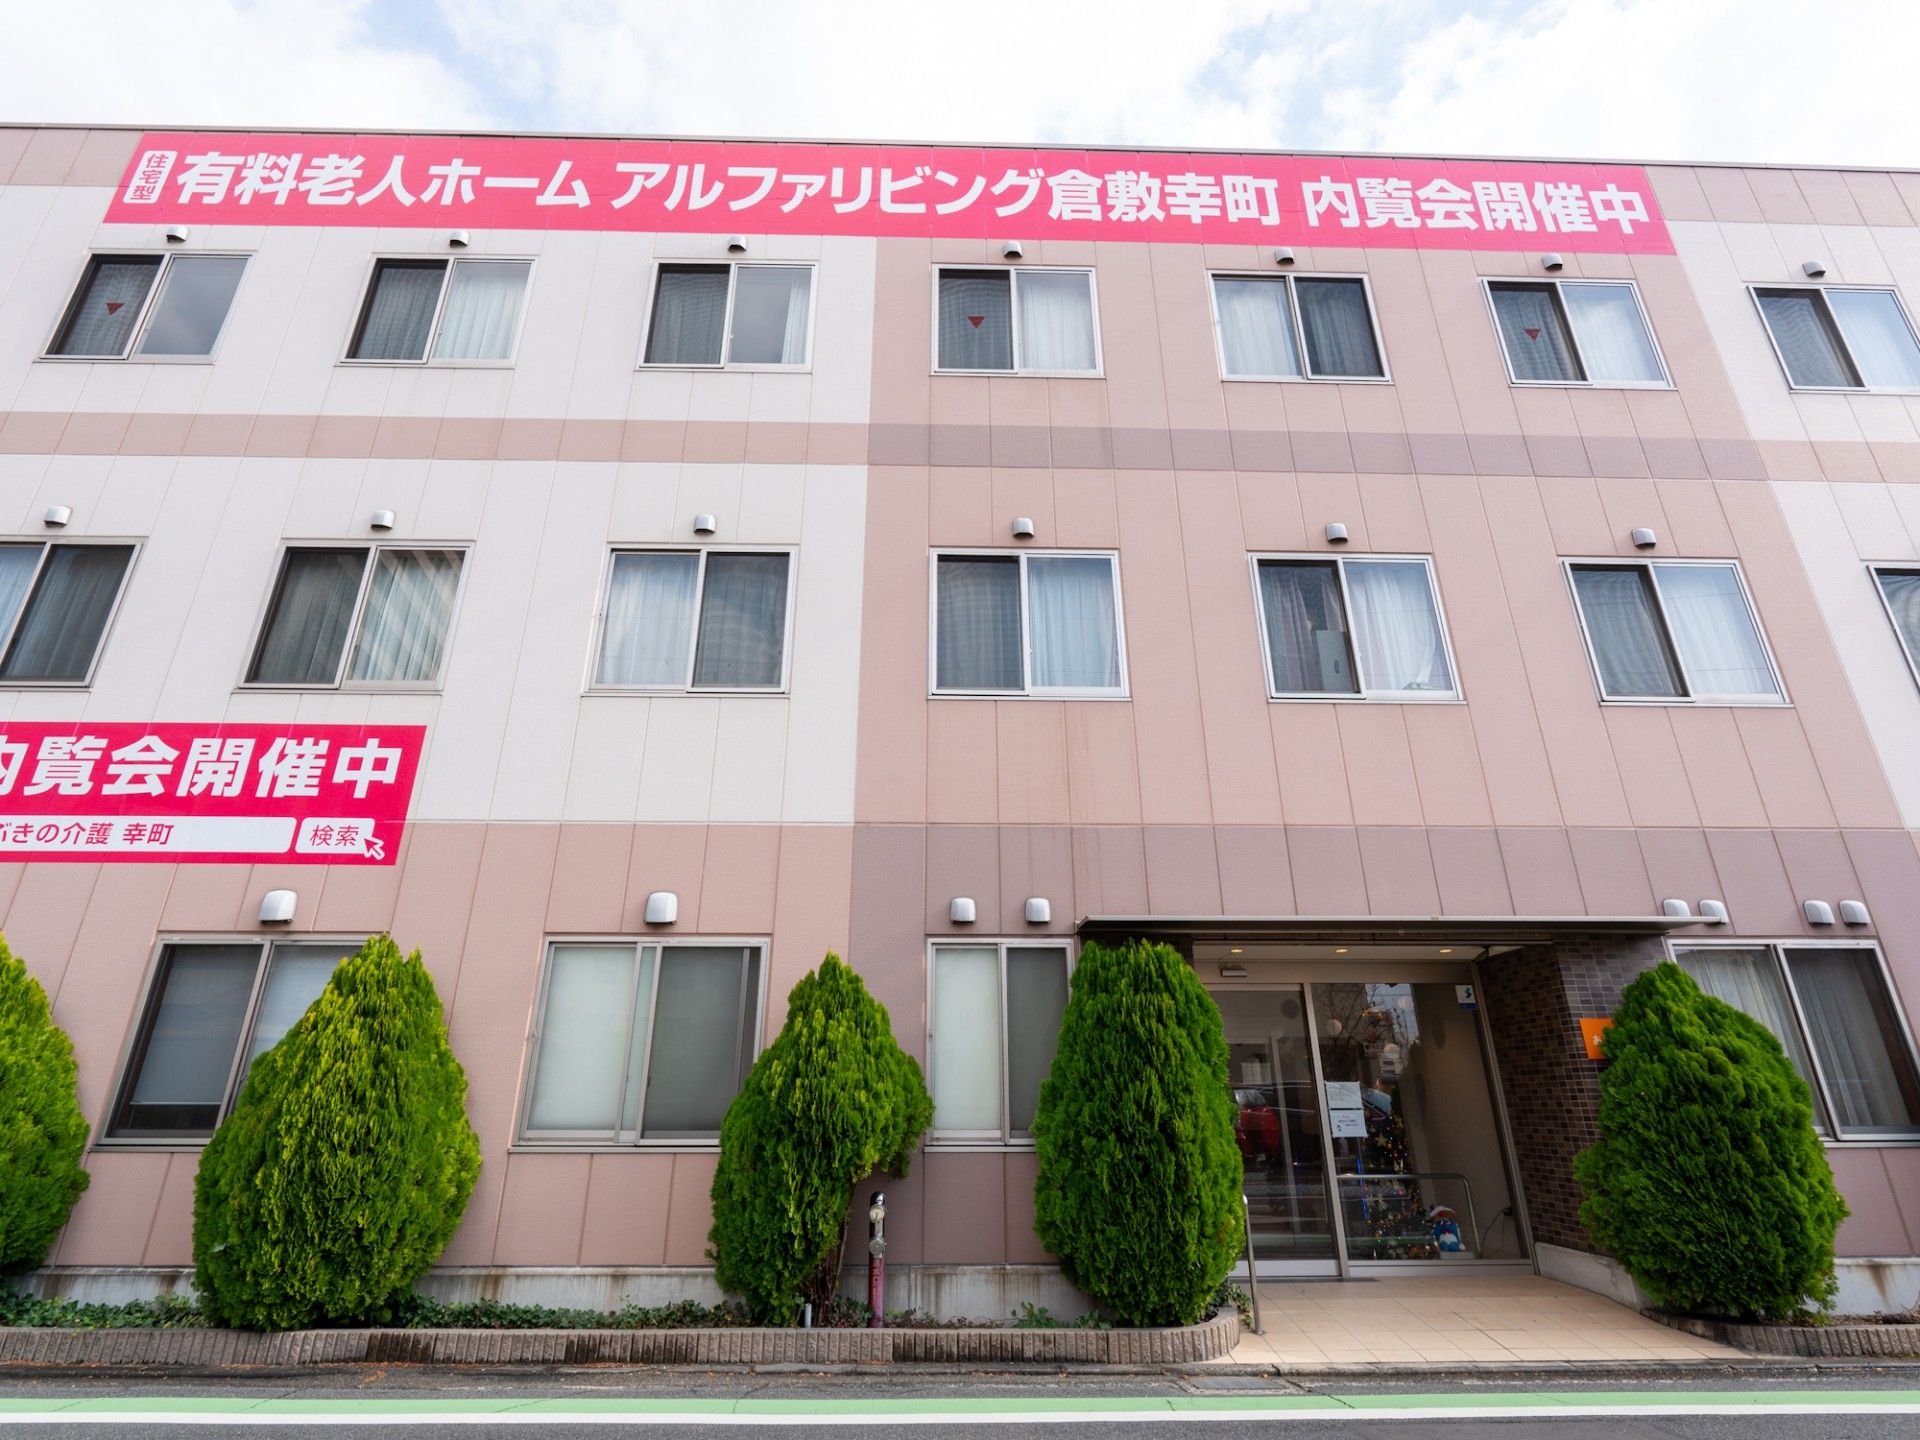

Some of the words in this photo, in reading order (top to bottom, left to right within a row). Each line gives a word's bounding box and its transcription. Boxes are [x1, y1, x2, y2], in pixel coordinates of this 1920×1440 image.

[130, 153, 169, 200] 住宅型
[176, 152, 592, 208] 有料老人ホーム
[611, 163, 1280, 226] アルファリビング倉敷幸町
[1304, 175, 1651, 235] 内覧会開催中
[123, 823, 174, 845] 幸町
[310, 824, 359, 846] 検索
